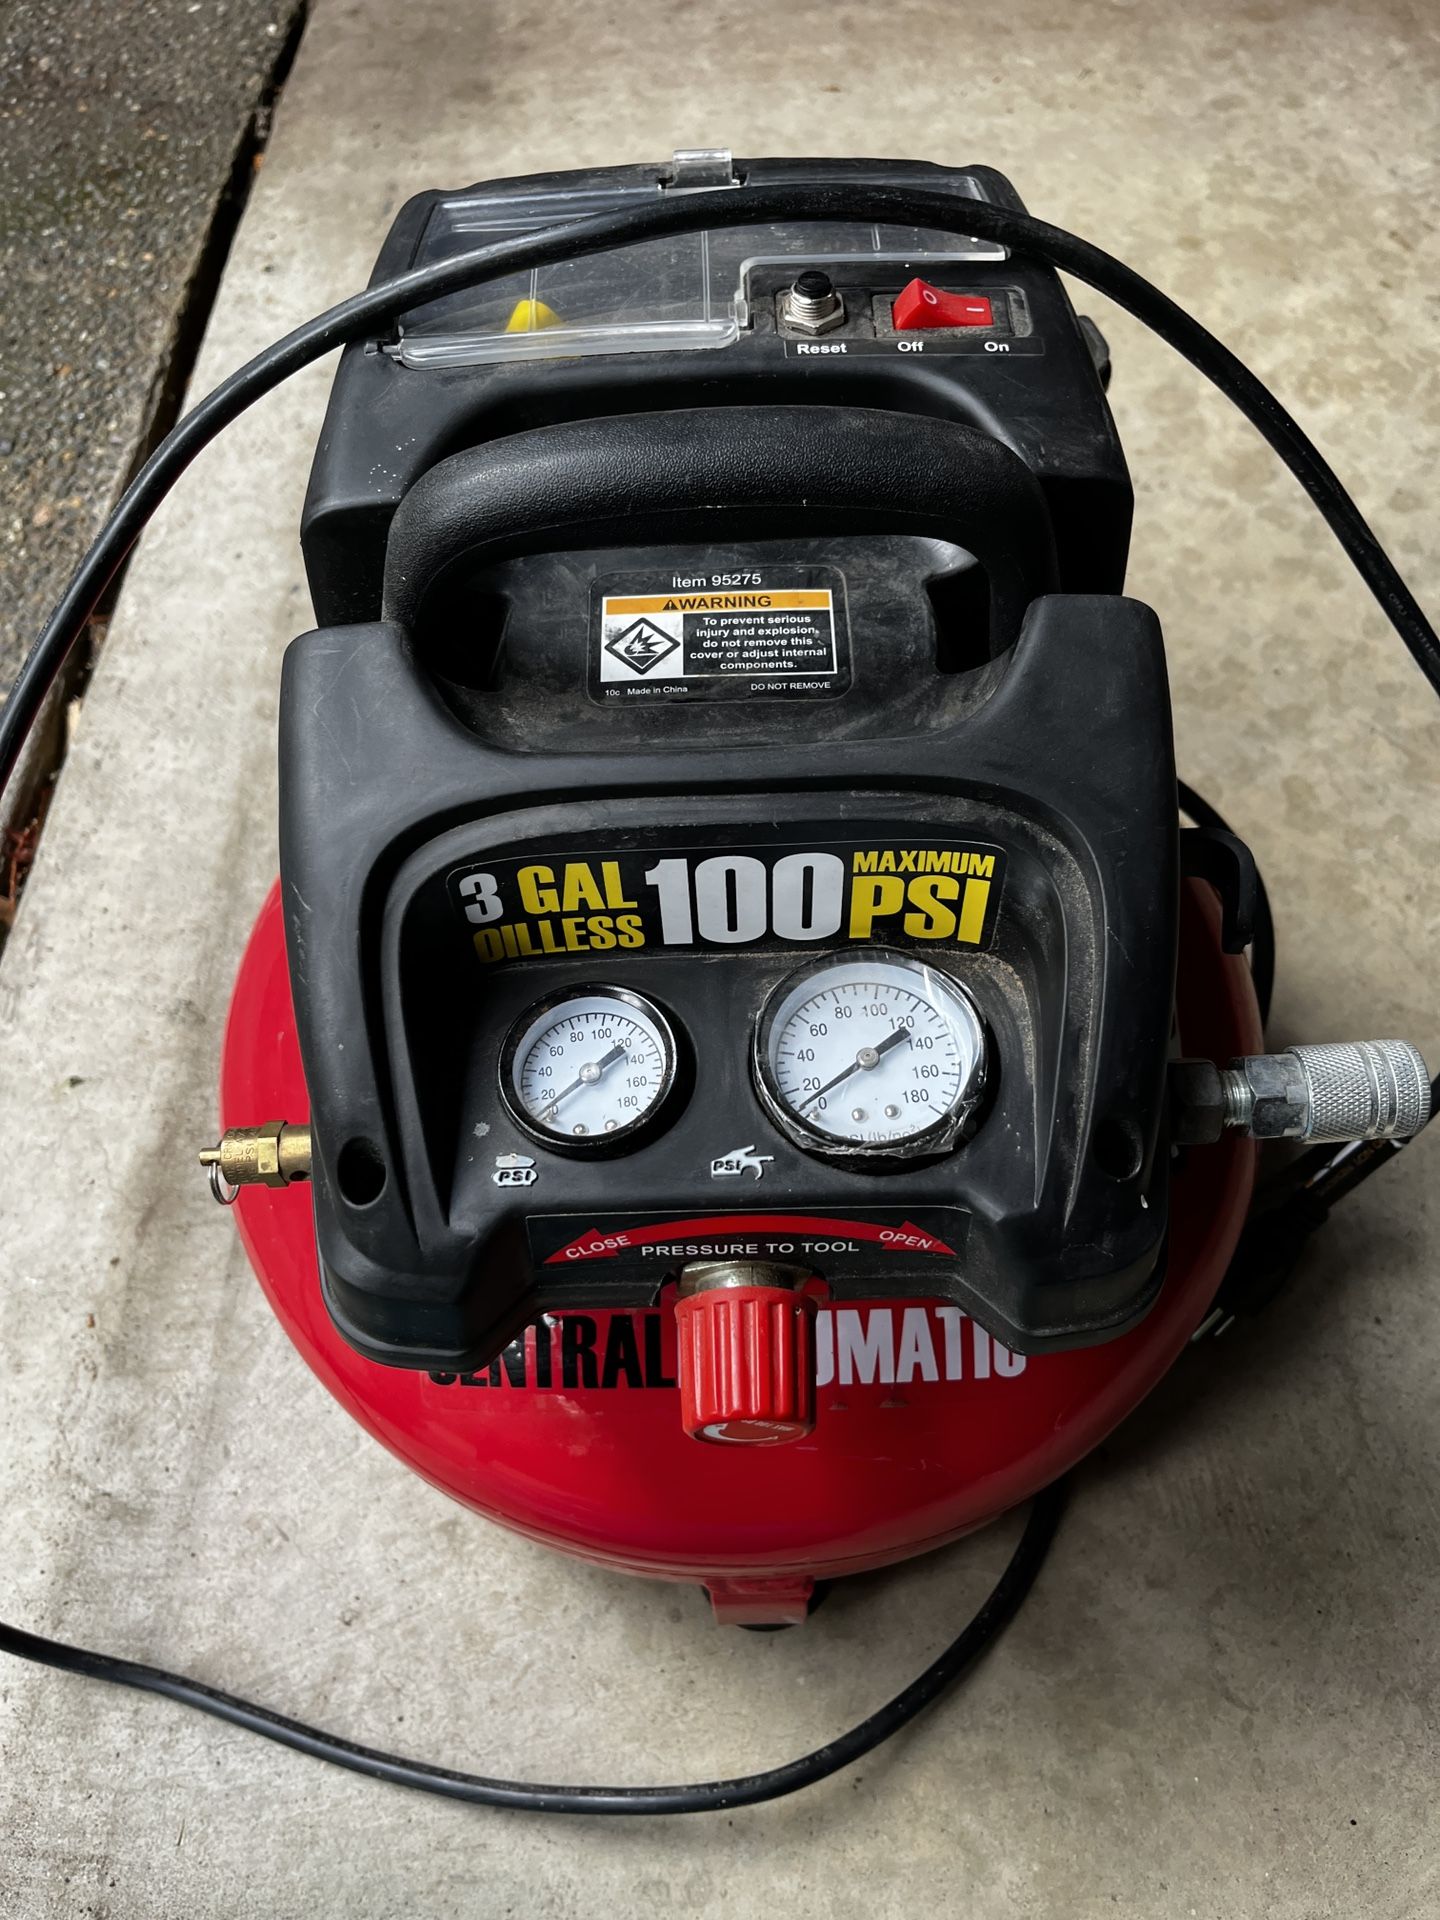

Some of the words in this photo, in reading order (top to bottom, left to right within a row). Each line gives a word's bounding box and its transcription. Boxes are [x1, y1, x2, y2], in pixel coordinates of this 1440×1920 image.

[797, 343, 847, 355] Reset
[897, 341, 924, 352] Off
[984, 341, 1010, 352] On
[672, 576, 707, 588] Item
[711, 574, 762, 586] 95275
[679, 595, 772, 609] WARNING
[703, 617, 717, 625] To
[720, 616, 764, 626] prevent
[767, 615, 811, 624] serious
[696, 628, 730, 638] injury
[733, 627, 755, 636] and
[703, 640, 718, 648] do
[721, 639, 741, 647] not
[744, 638, 787, 646] remove
[790, 637, 813, 645] this
[690, 651, 723, 659] cover
[742, 649, 779, 659] adjust
[782, 647, 827, 657] internal
[720, 660, 798, 670] components.
[627, 687, 650, 695] Made
[653, 686, 661, 694] in
[663, 685, 688, 693] China
[751, 683, 765, 691] DO
[767, 682, 788, 690] NOT
[790, 681, 831, 689] REMOVE
[853, 850, 996, 877] MAXIMUM
[459, 873, 504, 924] 3
[517, 861, 638, 915] GAL
[645, 852, 844, 945] 100
[849, 875, 991, 945] PSI
[473, 914, 645, 964] OILLESS
[835, 1006, 851, 1019] 80
[863, 1003, 887, 1017] 100
[888, 1015, 915, 1029] 120
[592, 1028, 612, 1039] 100
[810, 1023, 827, 1036] 60
[570, 1031, 584, 1042] 80
[611, 1037, 631, 1048] 120
[906, 1036, 933, 1051] 140
[550, 1046, 564, 1057] 60
[797, 1048, 815, 1061] 40
[625, 1054, 645, 1066] 140
[538, 1066, 552, 1077] 40
[912, 1064, 939, 1078] 160
[627, 1076, 647, 1087] 160
[803, 1077, 821, 1090] 20
[541, 1088, 555, 1100] 20
[903, 1089, 929, 1103] 180
[618, 1096, 638, 1108] 180
[818, 1097, 827, 1110] 0
[552, 1104, 559, 1115] 0
[713, 1160, 741, 1171] PSI
[498, 1171, 532, 1182] PSI
[879, 1230, 932, 1248] OPEN
[566, 1235, 631, 1258] CLOSE
[642, 1244, 758, 1256] PRESSURE
[766, 1243, 794, 1253] TO
[801, 1242, 860, 1253] TOOL
[427, 1314, 676, 1388] NTRAL
